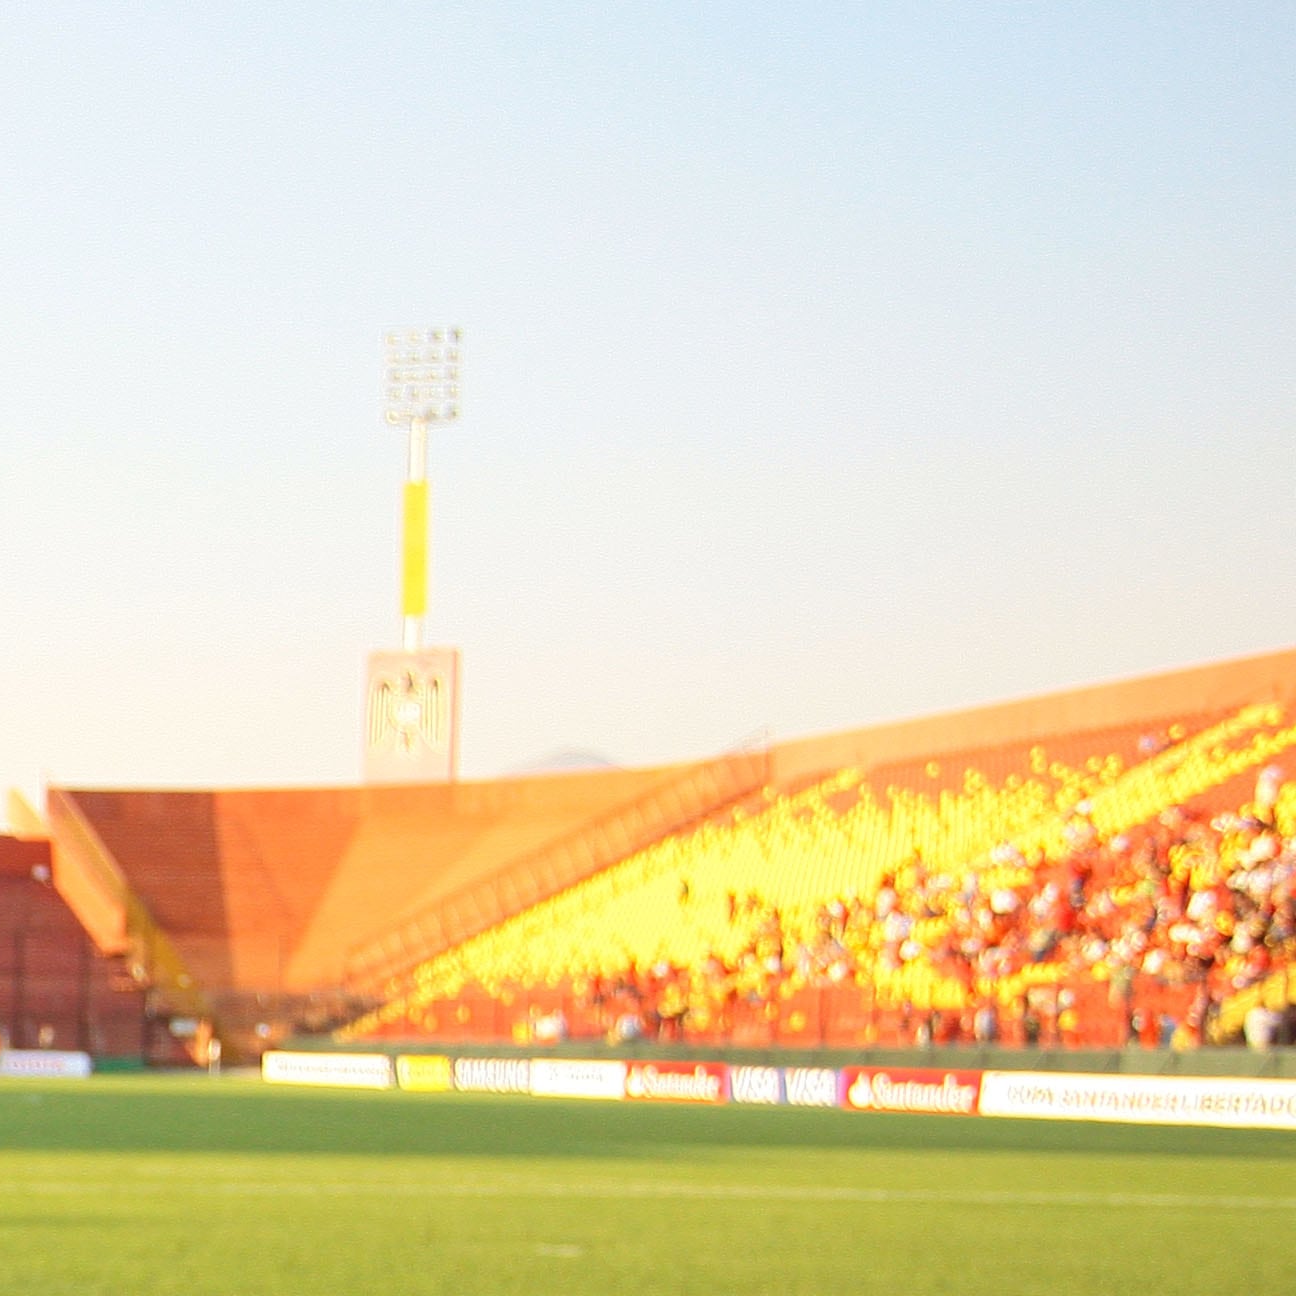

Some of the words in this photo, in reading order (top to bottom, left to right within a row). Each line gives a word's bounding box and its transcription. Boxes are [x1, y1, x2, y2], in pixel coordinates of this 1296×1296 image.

[455, 1056, 532, 1093] SAMSUNG
[643, 1064, 720, 1100] Santander
[729, 1065, 781, 1105] VISA
[784, 1067, 838, 1107] VISA
[871, 1072, 975, 1113] Santander
[1061, 1088, 1181, 1112] SANTANDER
